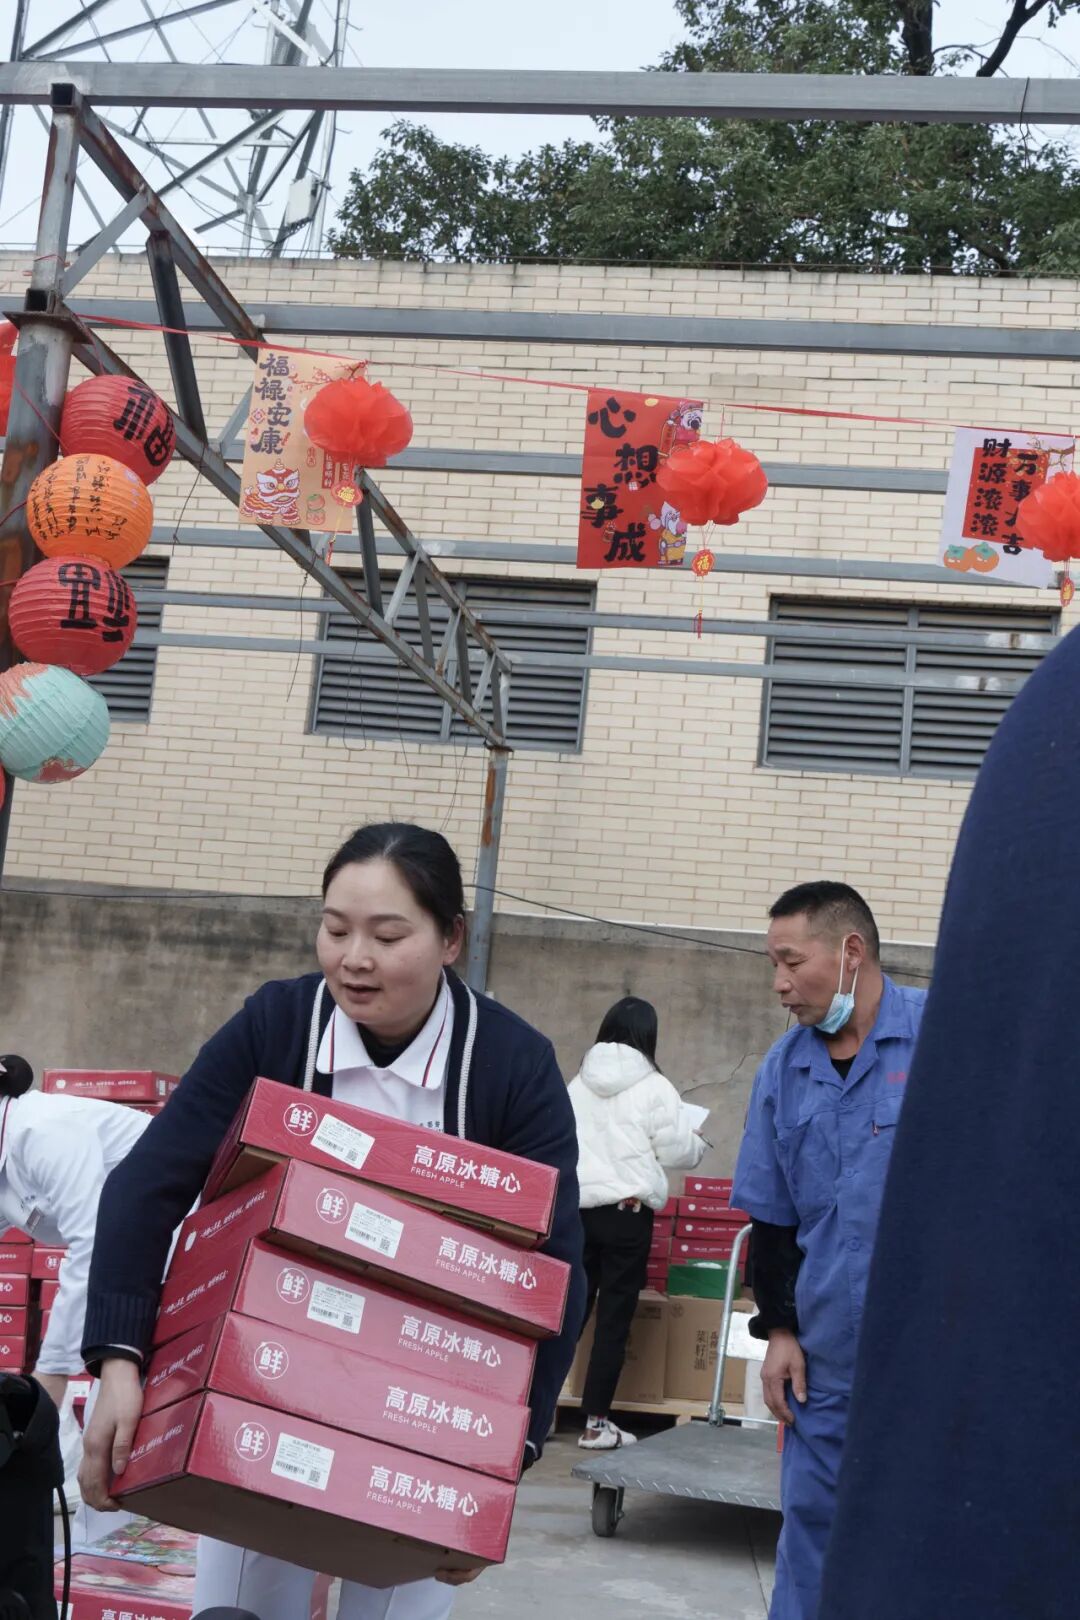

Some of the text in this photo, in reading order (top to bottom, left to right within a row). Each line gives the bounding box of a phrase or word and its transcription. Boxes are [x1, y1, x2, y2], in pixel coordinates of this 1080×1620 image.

[251, 353, 292, 455] 福禄安康
[581, 397, 658, 563] 心想事成
[970, 438, 1012, 537] 财源滚滚
[288, 1106, 311, 1132] 鲜
[410, 1166, 465, 1189] FRESH APPLE
[413, 1144, 522, 1194] 高原冰糖心
[320, 1191, 344, 1219] 鲜
[435, 1259, 487, 1283] FRESH APPLE
[437, 1236, 538, 1291] 高原冰糖心
[280, 1270, 303, 1299] 鲜
[398, 1338, 449, 1363] FRESH APPLE
[400, 1315, 502, 1369] 高原冰糖心
[258, 1343, 282, 1374] 鲜
[382, 1411, 438, 1435] FRESH APPLE
[385, 1385, 493, 1438] 高原冰糖心
[239, 1427, 264, 1456] 鲜
[366, 1492, 423, 1515] FRESH APPLE
[369, 1466, 479, 1517] 高原冰糖心
